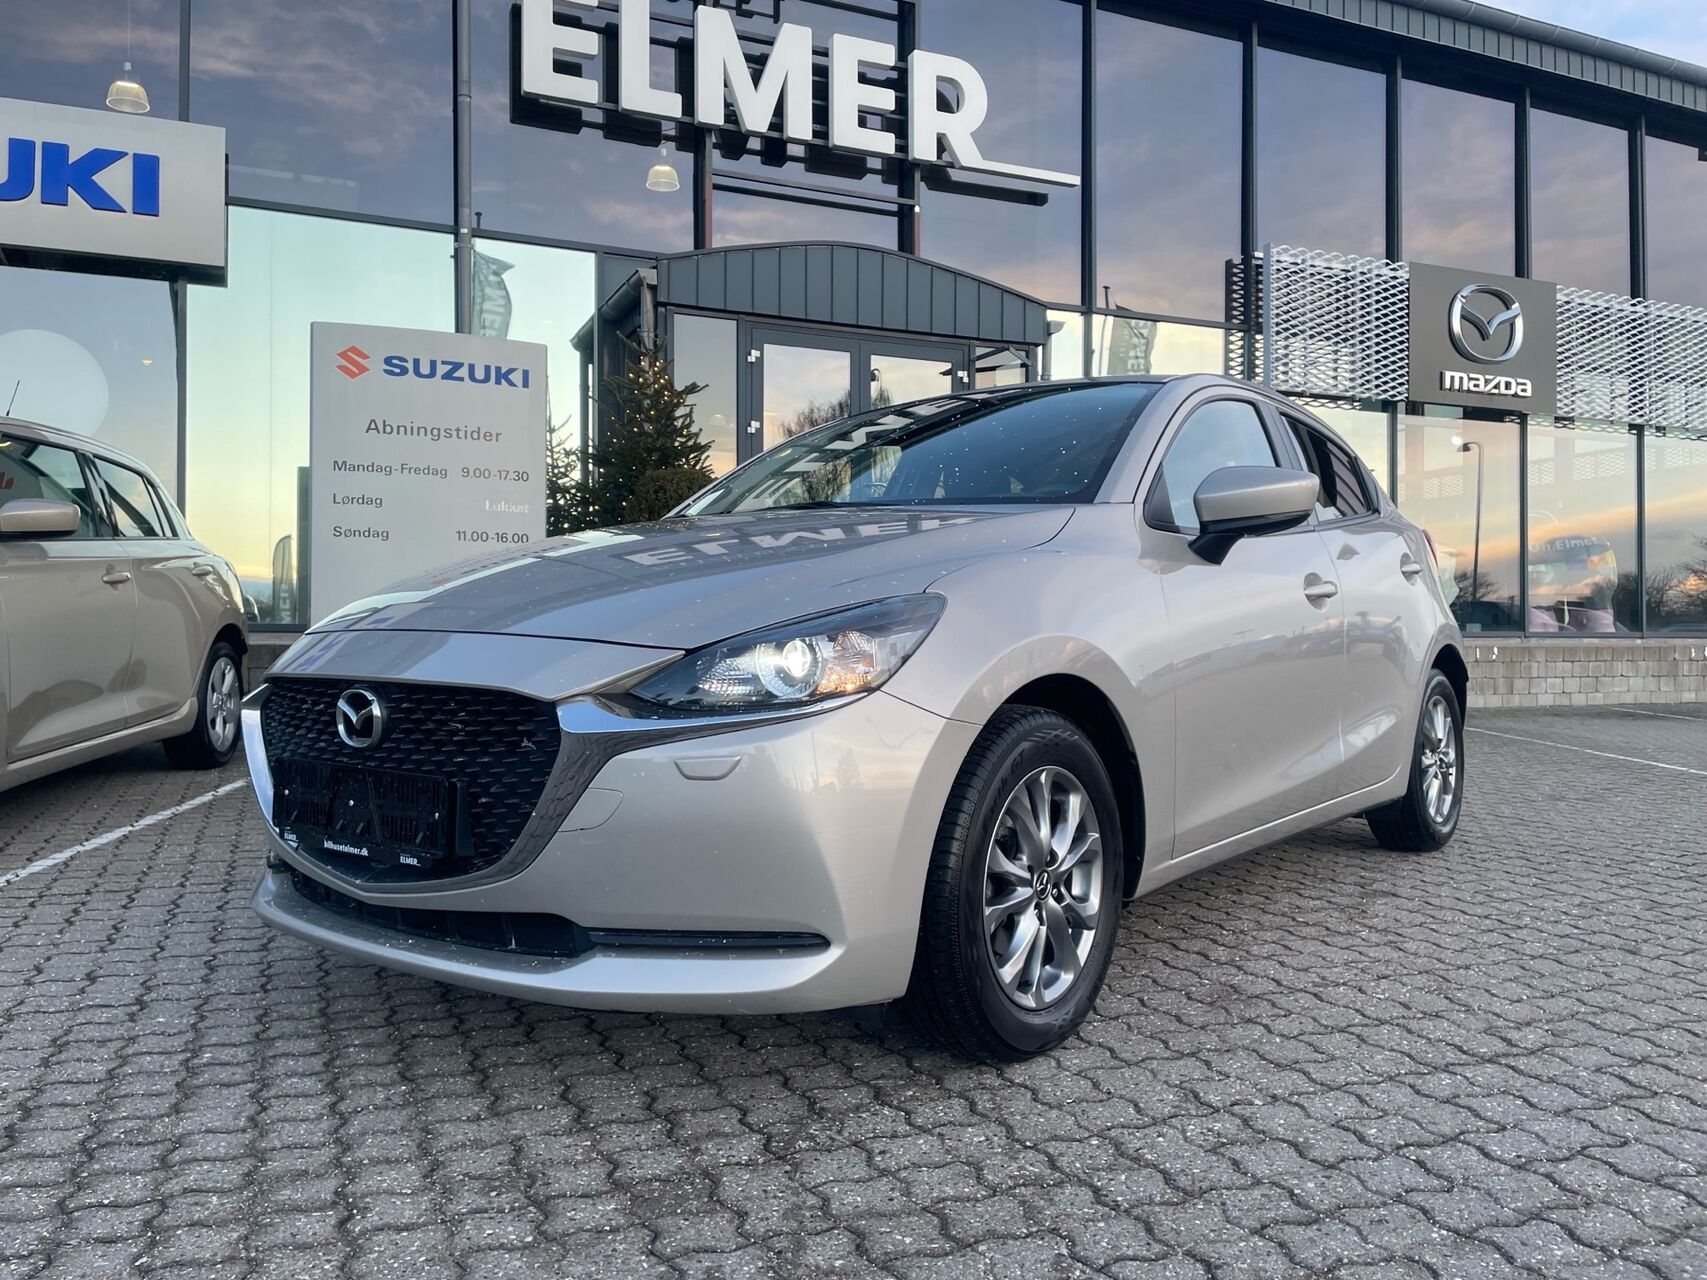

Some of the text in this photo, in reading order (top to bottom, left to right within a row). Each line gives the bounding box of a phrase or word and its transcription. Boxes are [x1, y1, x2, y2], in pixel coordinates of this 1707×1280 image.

[521, 0, 1080, 187] ELMER
[383, 355, 529, 389] SUZUKI
[365, 418, 502, 443] Abningstider
[332, 460, 529, 482] Mandag-Fredag 9.00-17.30
[332, 493, 383, 508] Lørdag
[332, 526, 529, 544] Søndag 11.00-16.00
